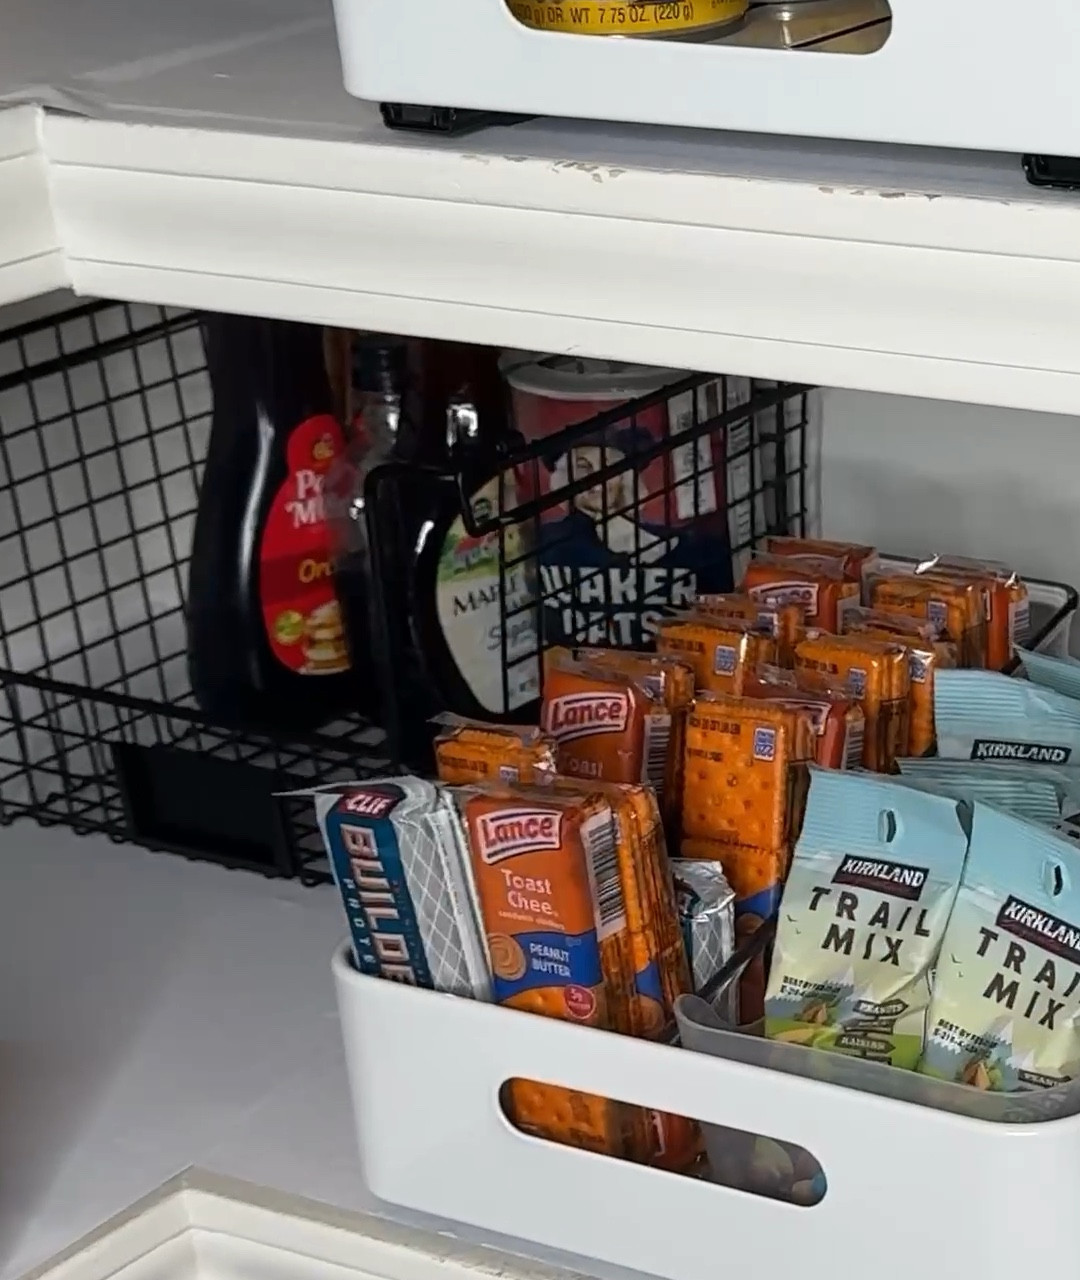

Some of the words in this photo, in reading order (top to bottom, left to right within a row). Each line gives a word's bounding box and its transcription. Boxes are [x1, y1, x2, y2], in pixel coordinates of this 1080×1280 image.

[551, 700, 622, 731] Lance
[976, 741, 1067, 762] KIRKLAND
[481, 815, 553, 850] Lance
[501, 868, 552, 896] Toast
[842, 858, 925, 888] KIRKLAND
[340, 823, 418, 987] BUILDE
[343, 878, 376, 965] PROTE
[808, 885, 931, 938] TRAIL
[529, 942, 571, 963] PEANUT
[821, 922, 904, 967] MIX
[531, 958, 572, 979] BUTTER
[982, 971, 1066, 1031] MIX
